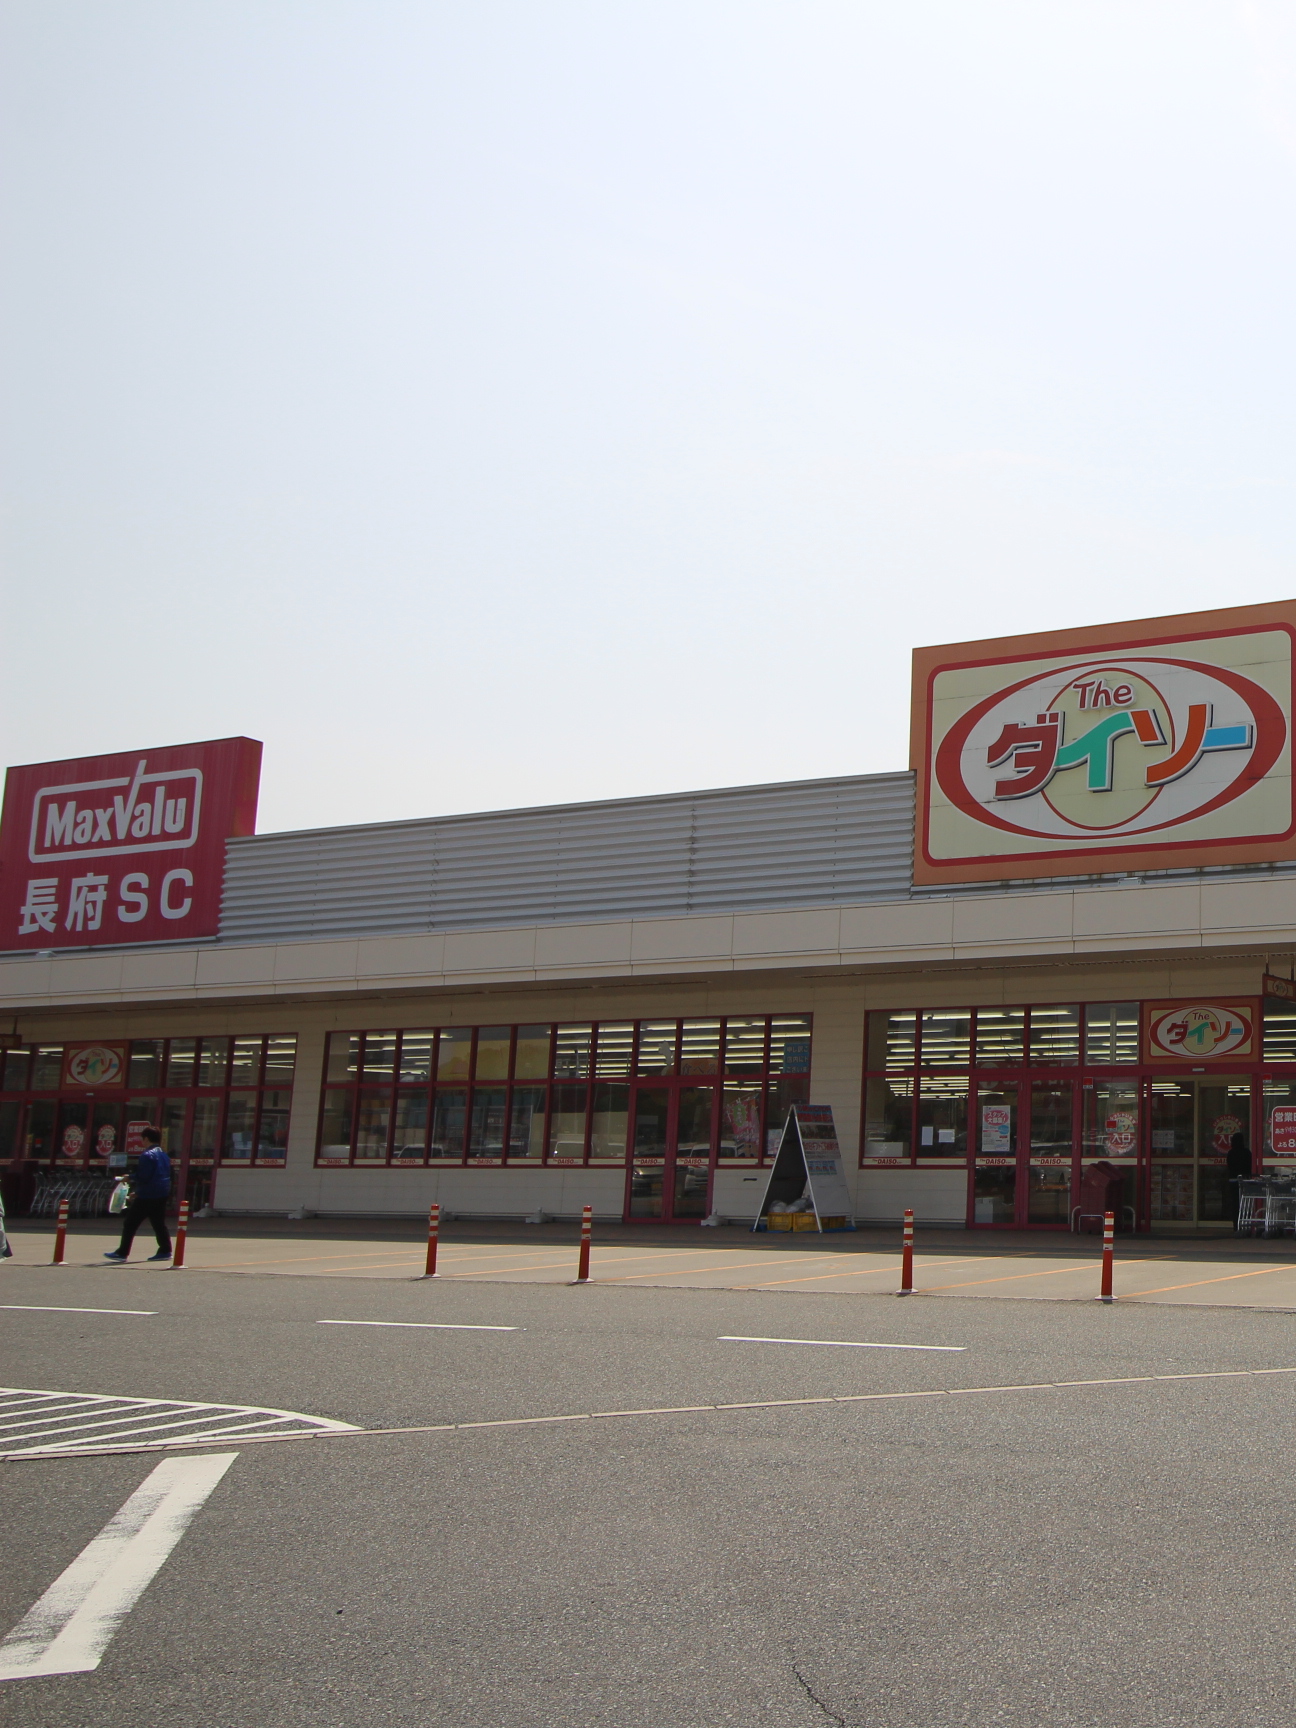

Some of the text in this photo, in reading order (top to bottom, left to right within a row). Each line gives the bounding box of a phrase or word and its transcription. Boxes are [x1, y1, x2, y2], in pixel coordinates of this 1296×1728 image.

[1072, 680, 1134, 709] The
[987, 701, 1252, 801] ダイソー
[44, 760, 187, 848] MaxValu
[18, 868, 194, 935] 長府SC
[1192, 1011, 1210, 1021] The
[1166, 1020, 1243, 1045] ダイソー
[76, 1057, 118, 1076] ダイソー
[1110, 1133, 1131, 1143] 入口
